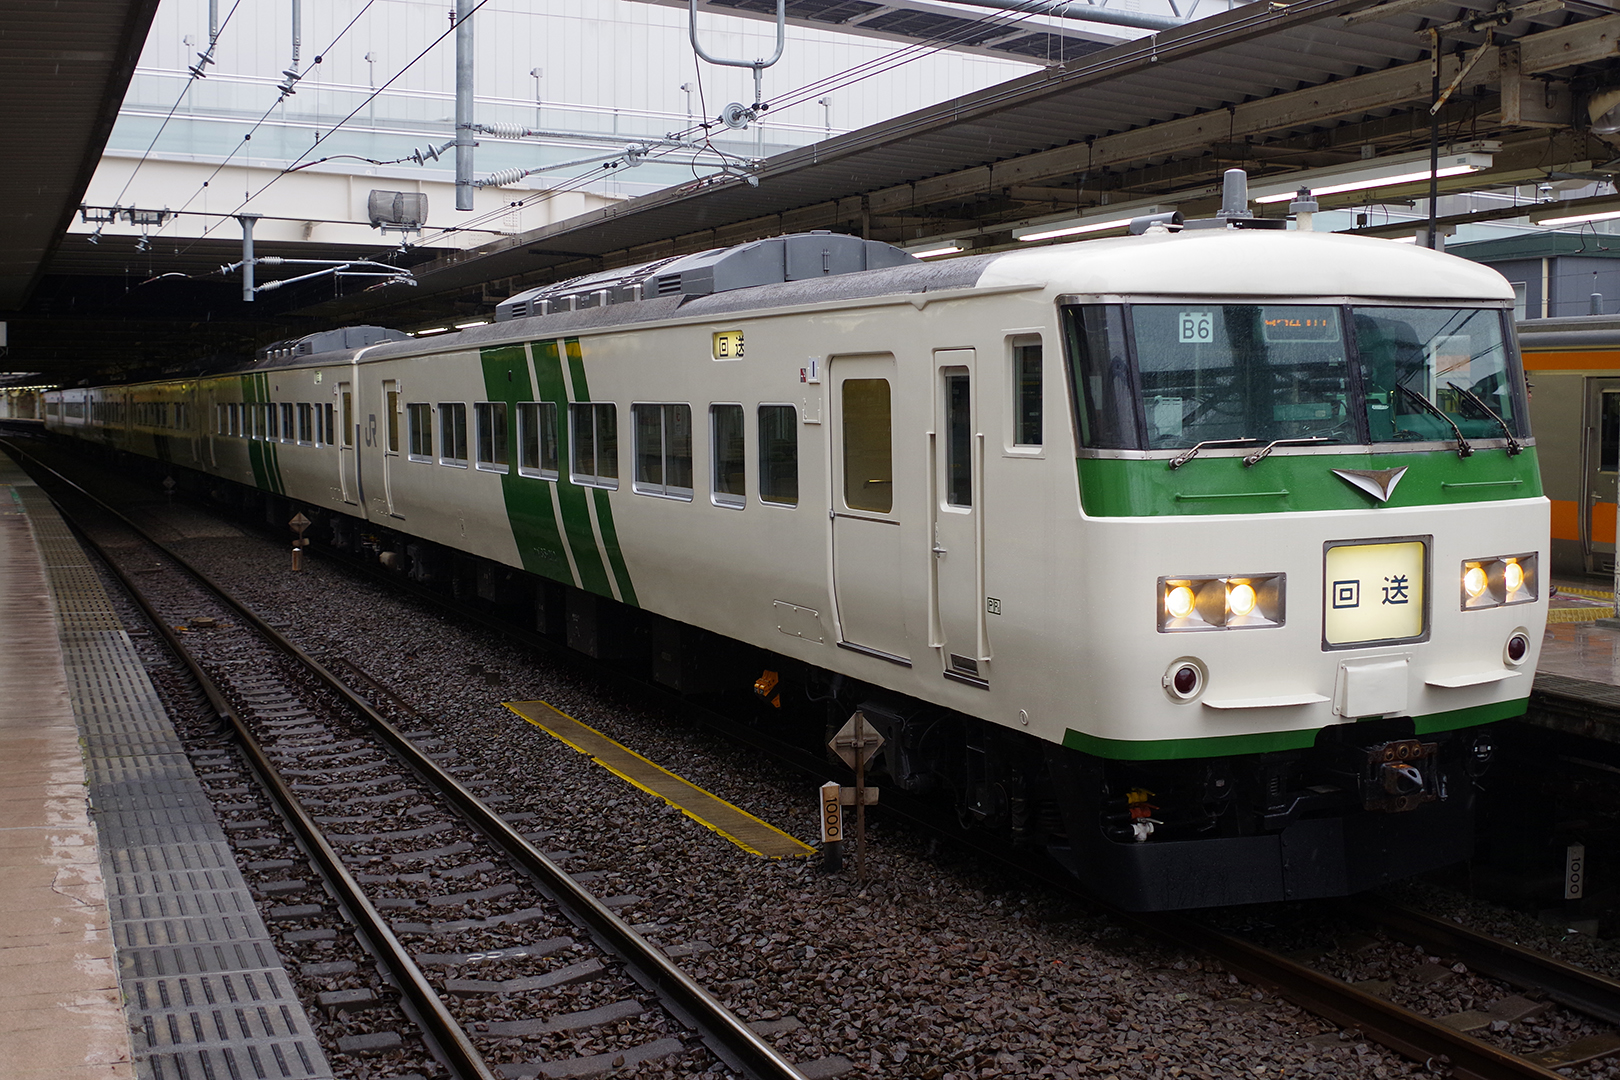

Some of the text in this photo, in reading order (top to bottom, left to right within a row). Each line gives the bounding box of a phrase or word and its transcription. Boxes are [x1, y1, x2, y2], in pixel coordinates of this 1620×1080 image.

[719, 335, 745, 357] 回送
[1183, 319, 1209, 339] B6
[365, 414, 377, 448] JR
[1333, 574, 1409, 609] 回送
[826, 797, 839, 837] 1000
[1570, 857, 1581, 895] 1000
